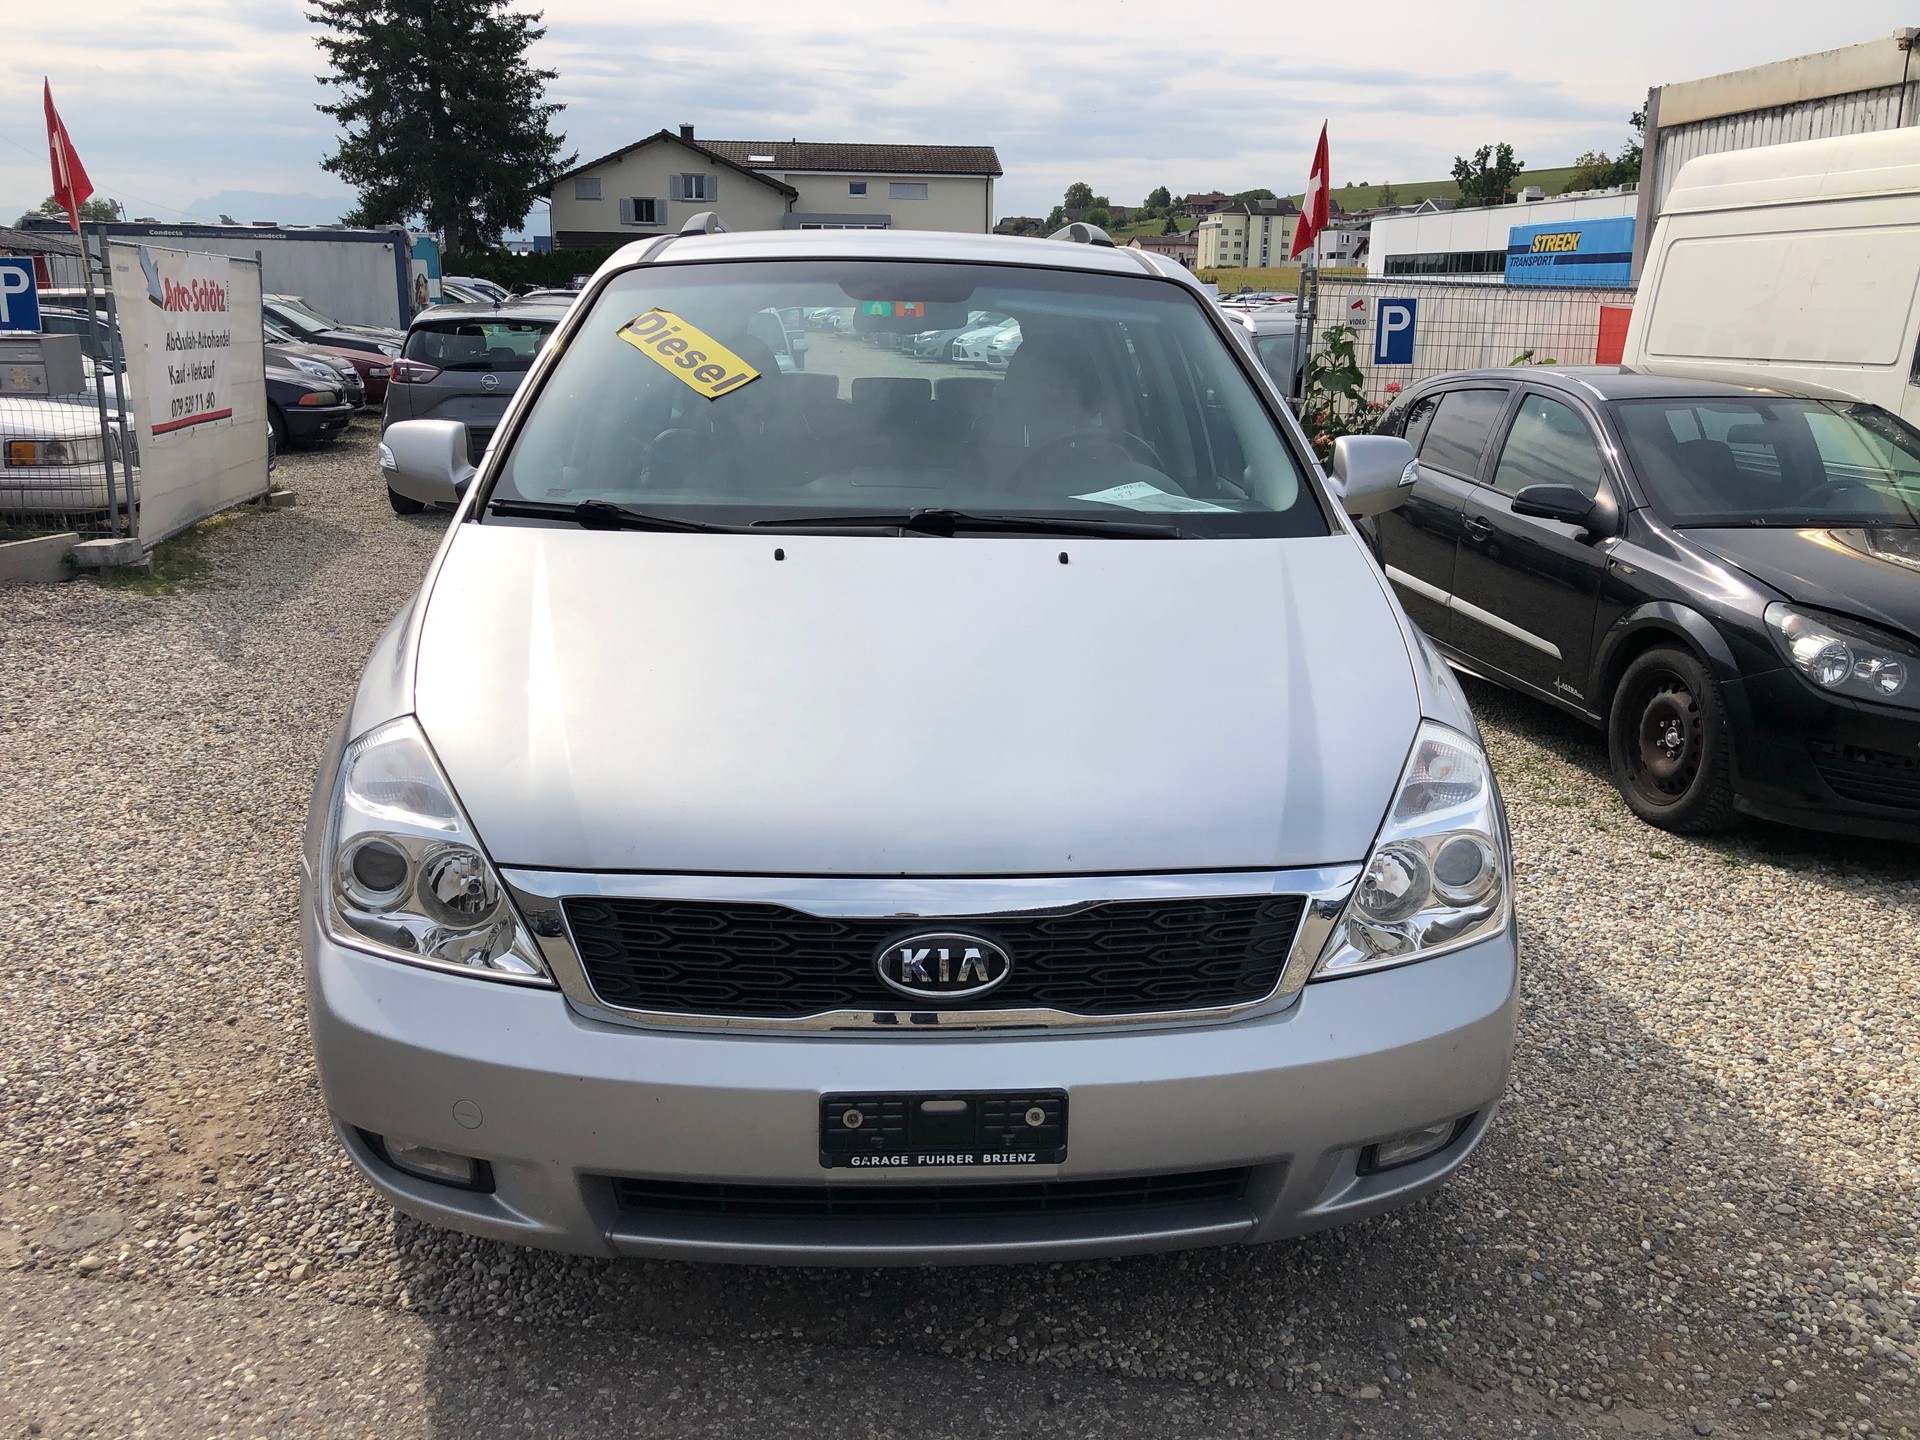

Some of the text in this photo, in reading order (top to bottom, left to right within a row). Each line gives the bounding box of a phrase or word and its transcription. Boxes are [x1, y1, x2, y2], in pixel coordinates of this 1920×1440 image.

[1532, 232, 1580, 253] STRECK
[1510, 255, 1553, 267] TRANSPORT
[0, 266, 30, 323] P
[164, 277, 226, 312] Auto-Schötz
[1349, 318, 1367, 326] VIDEO
[1380, 305, 1411, 358] P
[627, 312, 749, 393] Diesel
[168, 363, 186, 385] Kauf
[191, 360, 215, 381] Verkauf
[171, 397, 183, 418] 079
[195, 393, 204, 412] 11
[900, 948, 990, 982] KIA
[851, 1153, 1036, 1166] GARAGE FUHRER BRIENZ
